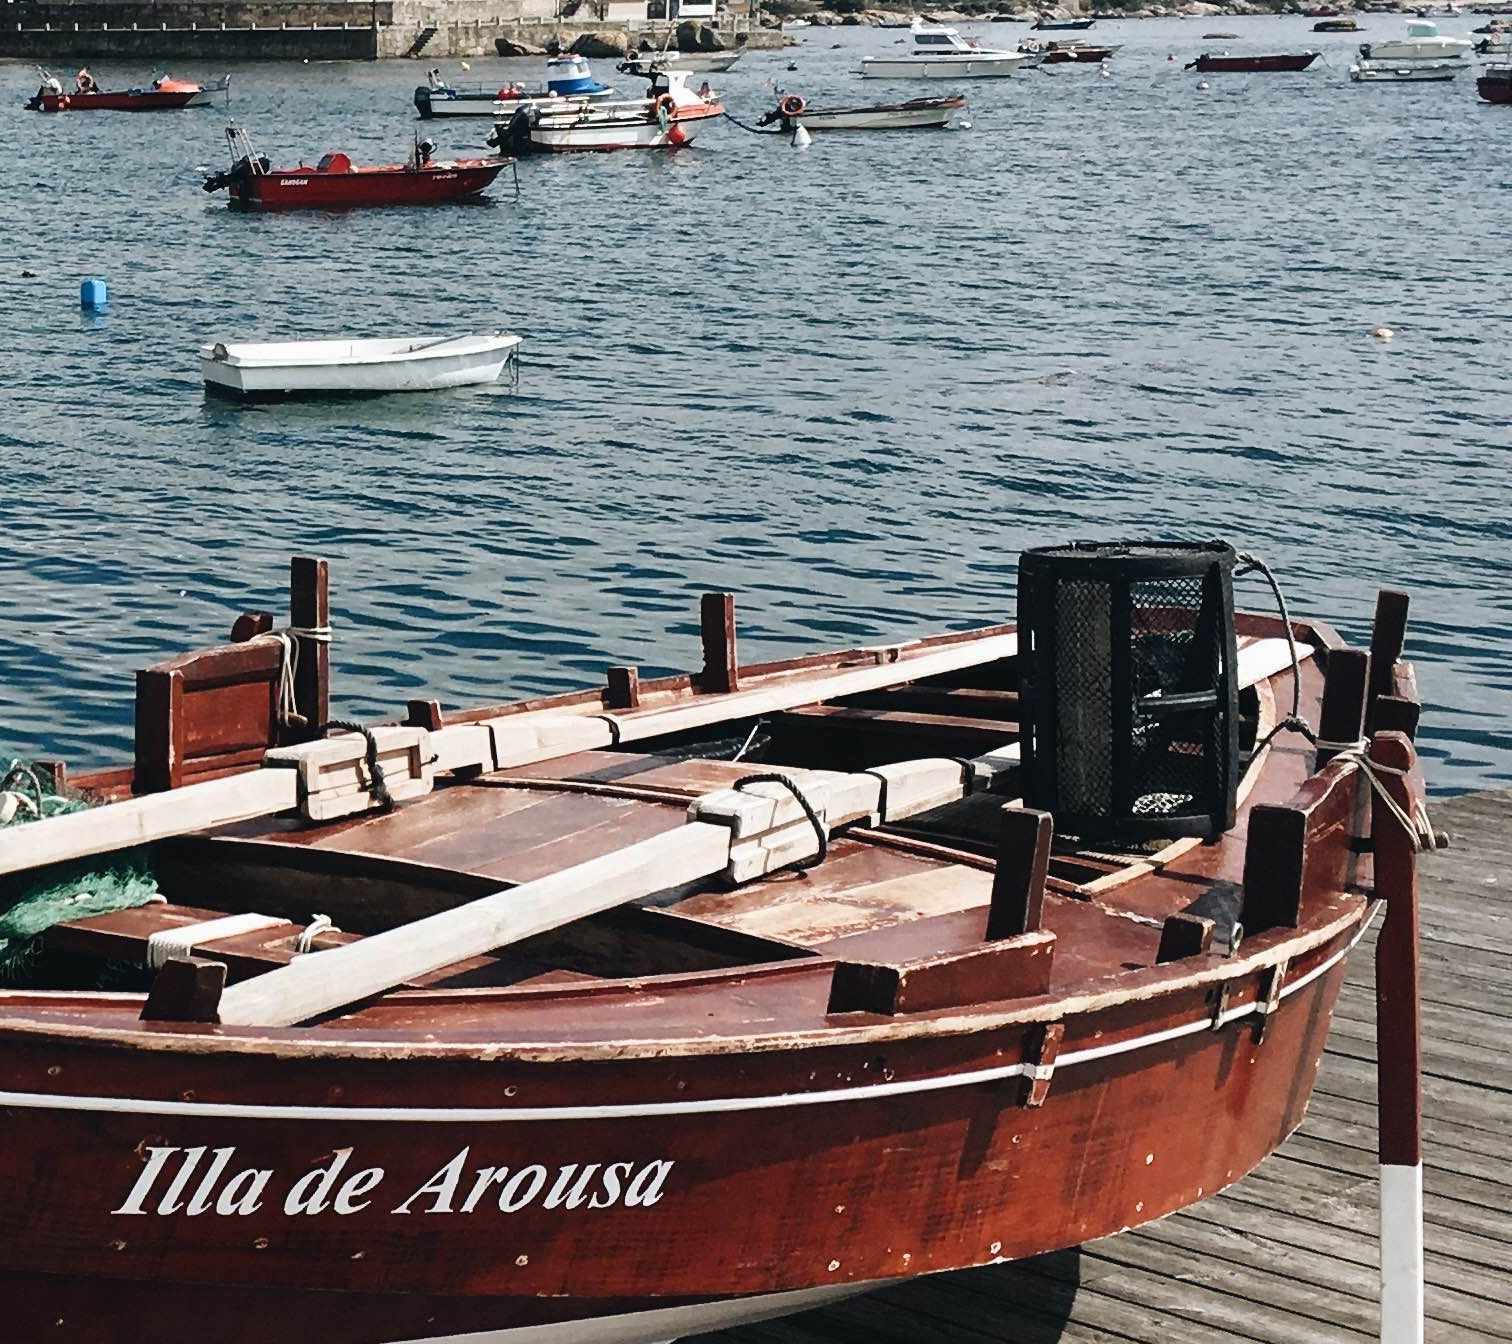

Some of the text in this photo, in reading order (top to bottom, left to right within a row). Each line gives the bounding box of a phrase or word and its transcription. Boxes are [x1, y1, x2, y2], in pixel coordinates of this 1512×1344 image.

[111, 1145, 676, 1216] Illa de Arousa
